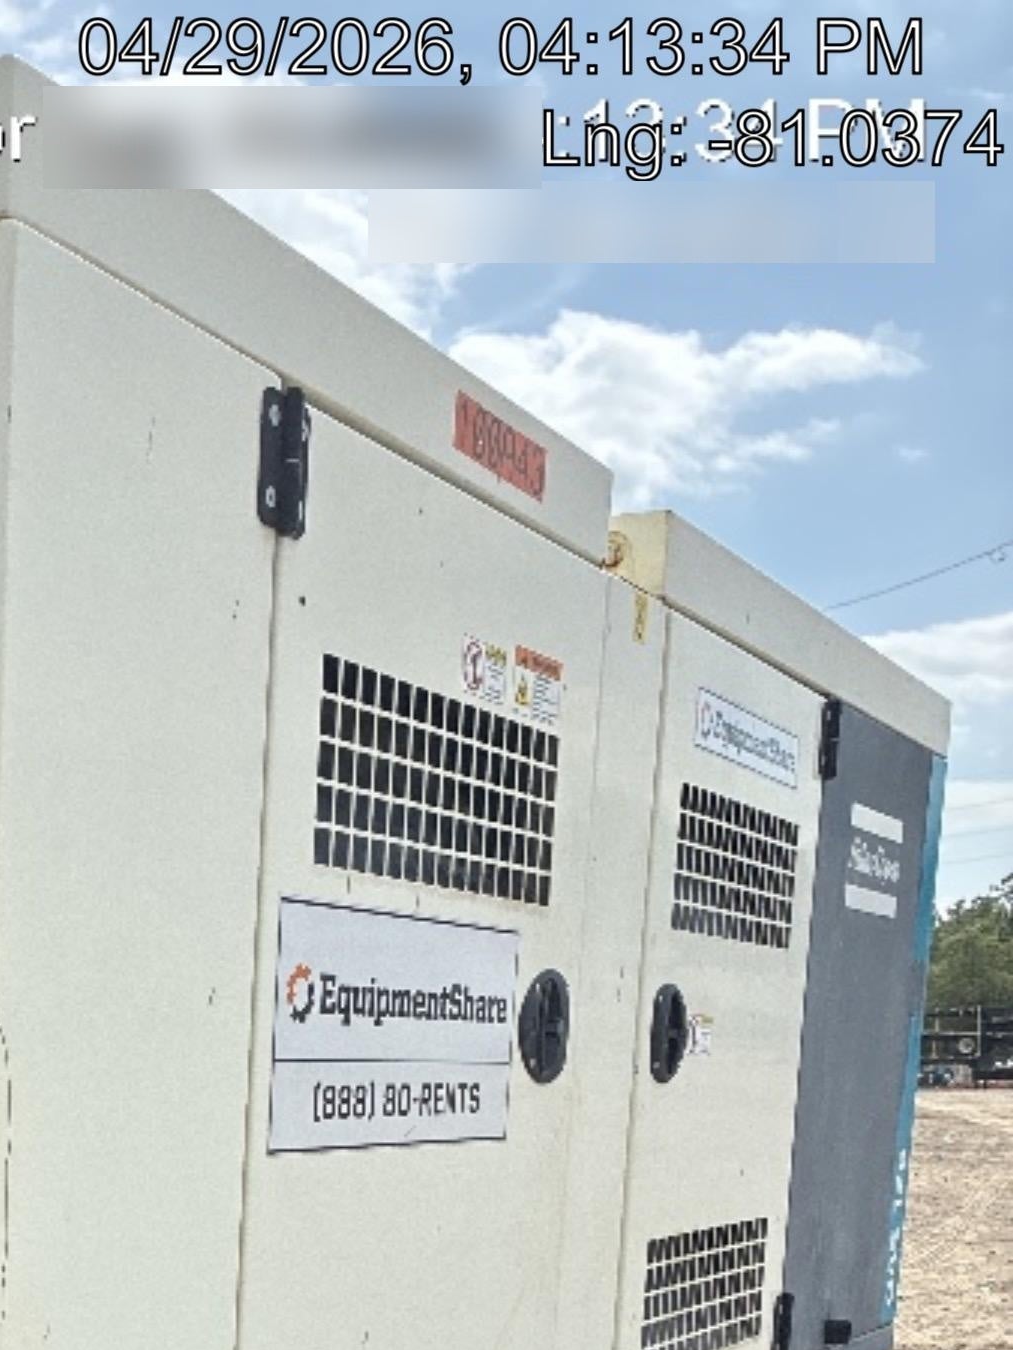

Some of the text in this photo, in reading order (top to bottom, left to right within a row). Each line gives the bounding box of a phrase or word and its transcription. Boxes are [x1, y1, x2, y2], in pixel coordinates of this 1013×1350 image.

[320, 972, 508, 1027] EquipmentShare
[313, 1081, 481, 1122] (888) 80-RENTS
